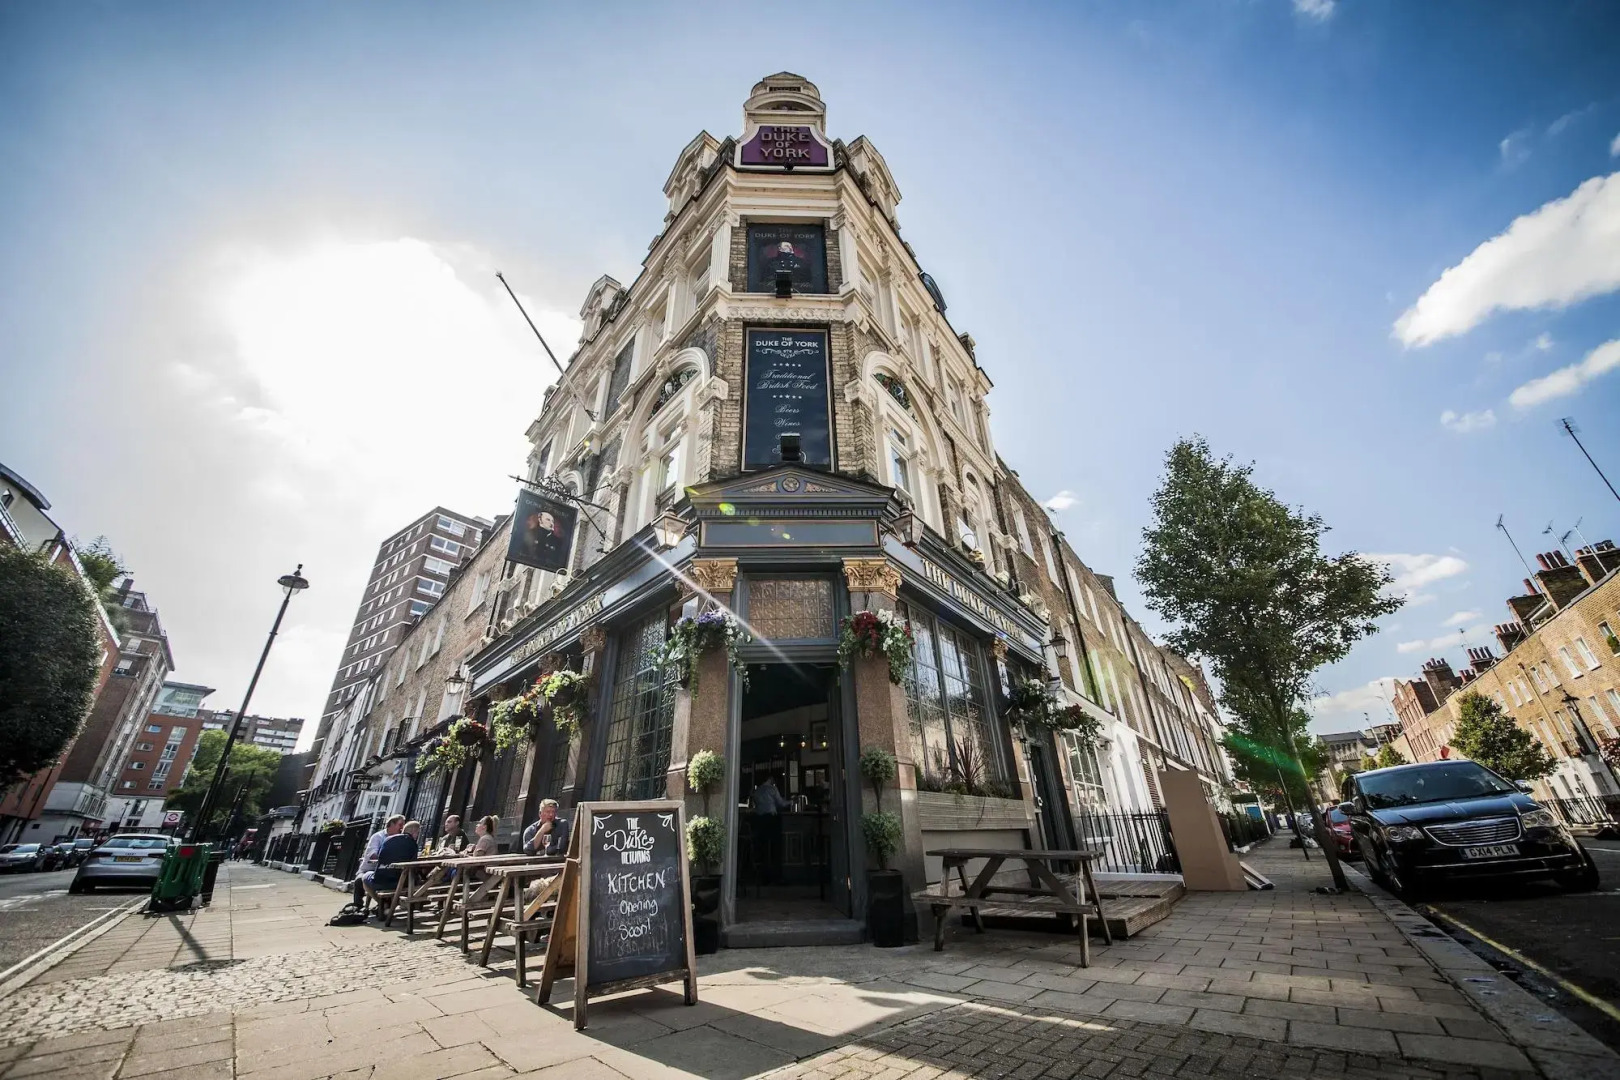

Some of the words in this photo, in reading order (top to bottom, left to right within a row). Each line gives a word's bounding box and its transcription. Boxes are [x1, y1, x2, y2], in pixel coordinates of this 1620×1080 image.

[761, 133, 811, 141] DUKE
[760, 148, 811, 158] YORK
[761, 369, 816, 379] Traditional
[756, 380, 792, 390] British
[791, 380, 819, 390] Food
[774, 404, 800, 413] Beers
[774, 417, 801, 427] Wines
[922, 558, 950, 592] THE
[953, 581, 985, 614] DUKE
[626, 817, 640, 830] THE
[1469, 847, 1493, 857] GX14
[1493, 845, 1516, 856] PLN
[621, 850, 650, 865] RETURNS
[619, 899, 659, 917] Opening
[618, 917, 652, 940] Soon!
